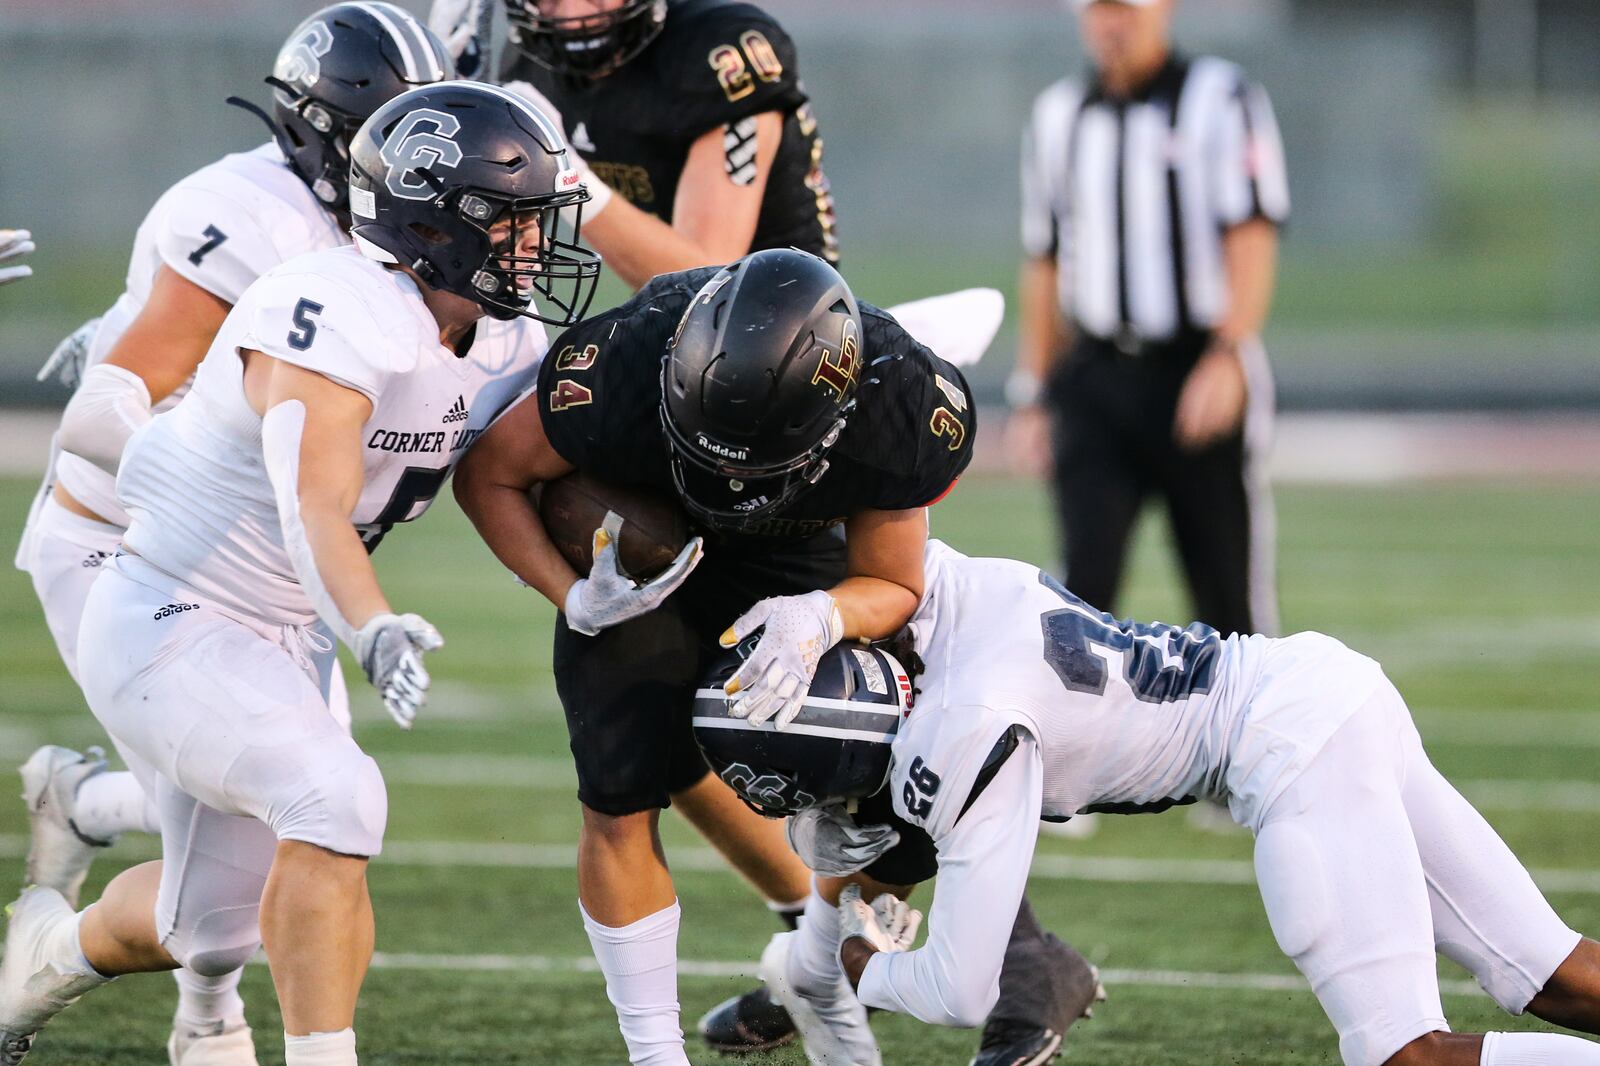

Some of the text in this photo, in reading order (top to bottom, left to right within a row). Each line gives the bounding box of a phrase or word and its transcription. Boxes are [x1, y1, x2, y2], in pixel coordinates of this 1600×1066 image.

[708, 30, 783, 101] 20
[380, 108, 463, 201] CC
[189, 223, 228, 267] 7
[286, 297, 324, 351] 5
[550, 343, 599, 413] 34
[368, 429, 445, 453] CORNER
[698, 436, 747, 461] Riddell
[153, 603, 200, 620] adidas
[903, 755, 941, 821] 26
